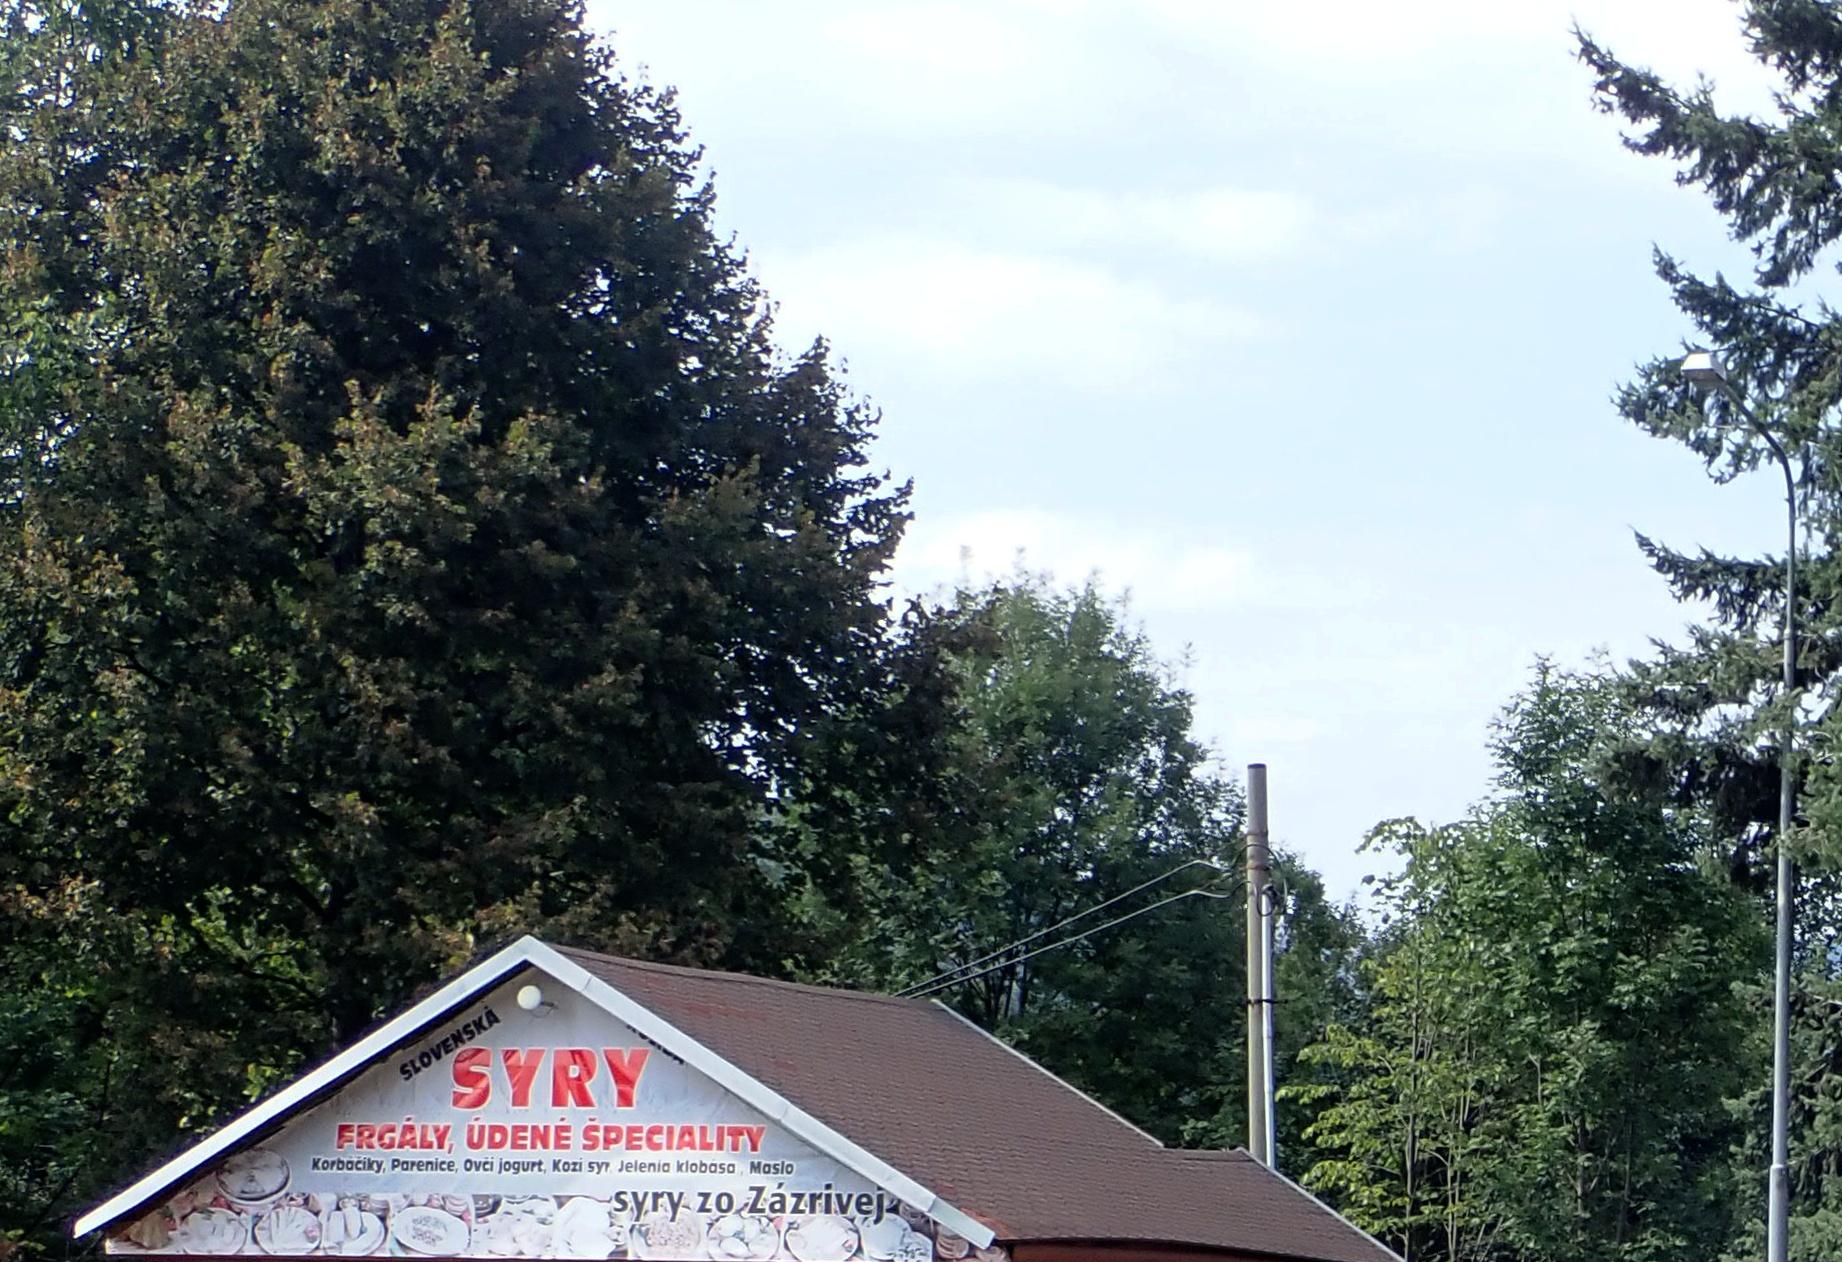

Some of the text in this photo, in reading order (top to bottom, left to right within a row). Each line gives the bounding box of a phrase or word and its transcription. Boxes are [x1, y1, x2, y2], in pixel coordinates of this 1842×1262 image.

[400, 1005, 500, 1081] SLOVENSKÁ
[451, 1047, 650, 1110] SYRY
[336, 1117, 766, 1154] FRGÁLY, ÚDENÉ ŠPECIALITY
[391, 1158, 458, 1173] Parenice,
[618, 1159, 671, 1173] Jelenia
[750, 1160, 794, 1175] Maslo
[613, 1182, 886, 1224] syry zo Zázrivej
